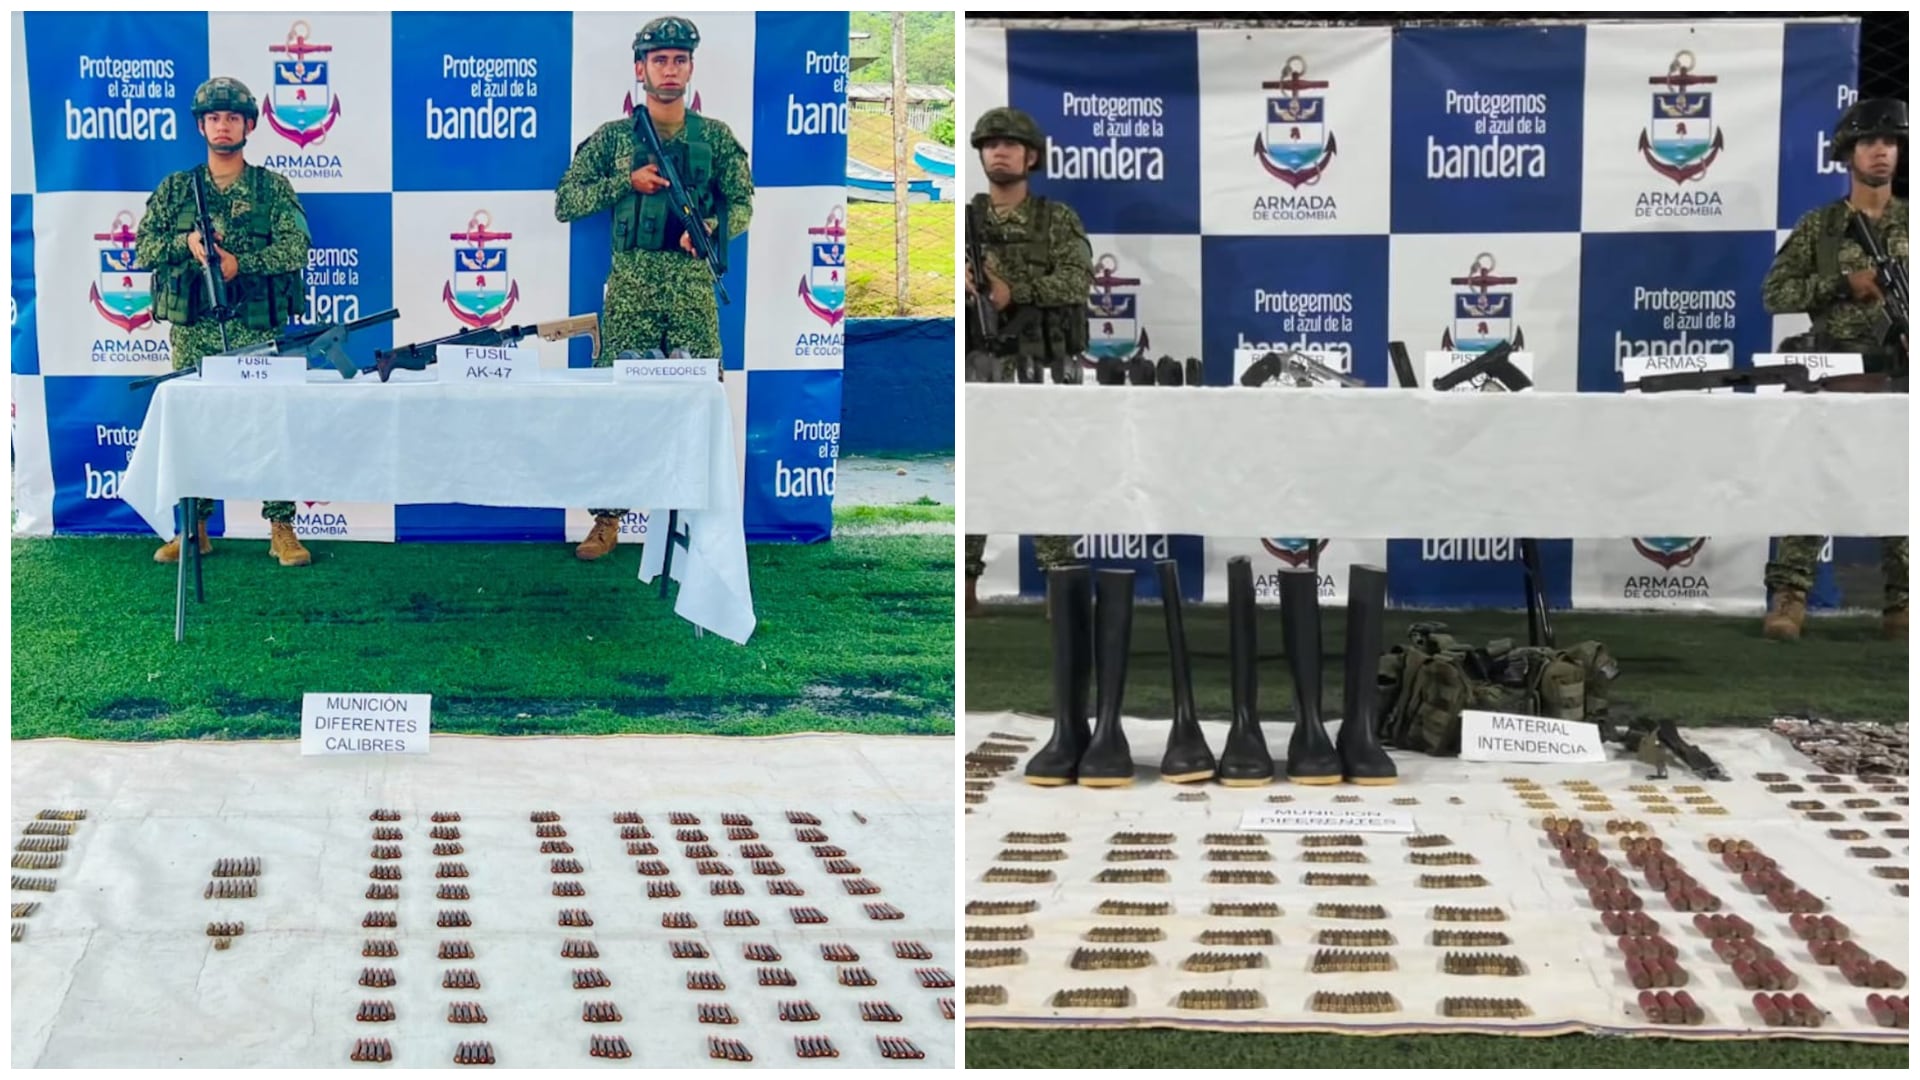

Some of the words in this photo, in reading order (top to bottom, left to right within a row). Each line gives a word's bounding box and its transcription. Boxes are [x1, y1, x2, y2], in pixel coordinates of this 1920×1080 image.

[80, 55, 174, 83] Protegemos
[443, 54, 537, 82] Protegemos
[108, 80, 118, 98] el
[121, 80, 145, 98] azul
[148, 80, 162, 98] de
[164, 80, 175, 98] la
[471, 79, 481, 97] el
[483, 79, 507, 97] azul
[510, 79, 524, 97] de
[527, 79, 537, 97] la
[833, 75, 844, 93] el
[1063, 92, 1163, 121] Protegemos
[1446, 88, 1546, 119] Protegemos
[65, 98, 176, 140] bandera
[426, 97, 537, 139] bandera
[1475, 116, 1486, 134] el
[1488, 116, 1514, 134] azul
[1517, 116, 1532, 134] de
[1535, 116, 1546, 134] la
[1093, 119, 1104, 137] el
[1106, 119, 1131, 137] azul
[1134, 119, 1150, 137] de
[1152, 119, 1164, 137] la
[263, 155, 342, 168] ARMADA
[1046, 135, 1164, 180] bandera
[1427, 134, 1546, 179] bandera
[1254, 196, 1337, 210] ARMADA
[1635, 191, 1722, 206] ARMADA
[1253, 211, 1268, 220] DE
[1272, 211, 1337, 220] COLOMBIA
[1635, 207, 1651, 217] DE
[1655, 207, 1722, 216] COLOMBIA
[307, 248, 358, 271] gemos
[306, 268, 329, 285] azul
[332, 268, 346, 285] de
[348, 268, 359, 285] la
[287, 286, 359, 325] dera
[1255, 288, 1352, 317] Protegemos
[1634, 286, 1736, 314] Protegemos
[1283, 314, 1294, 332] el
[1297, 314, 1321, 332] azul
[1324, 314, 1339, 332] de
[1342, 314, 1352, 332] la
[1663, 311, 1674, 329] el
[1677, 311, 1703, 329] azul
[1705, 311, 1721, 329] de
[1724, 311, 1736, 329] la
[92, 339, 170, 352] ARMADA
[465, 348, 512, 361] FUSIL
[795, 347, 810, 356] DE
[92, 353, 106, 362] DE
[109, 353, 170, 362] COLOMBIA
[1645, 356, 1708, 369] ARMAS
[241, 370, 268, 379] M-15
[466, 366, 512, 378] AK-47
[626, 366, 706, 376] PROVEEDORES
[96, 424, 140, 447] Prote
[819, 442, 828, 458] el
[293, 513, 347, 526] MADA
[293, 526, 347, 535] OLOMBIA
[1074, 534, 1168, 559] andera
[1624, 576, 1709, 589] ARMADA
[1624, 589, 1640, 598] DE
[1643, 589, 1709, 598] COLOMBIA
[326, 696, 407, 712] MUNICIÓN
[314, 716, 417, 733] DIFERENTES
[1491, 716, 1570, 736] MATERIAL
[325, 737, 406, 751] CALIBRES
[1478, 735, 1588, 755] INTENDENCIA
